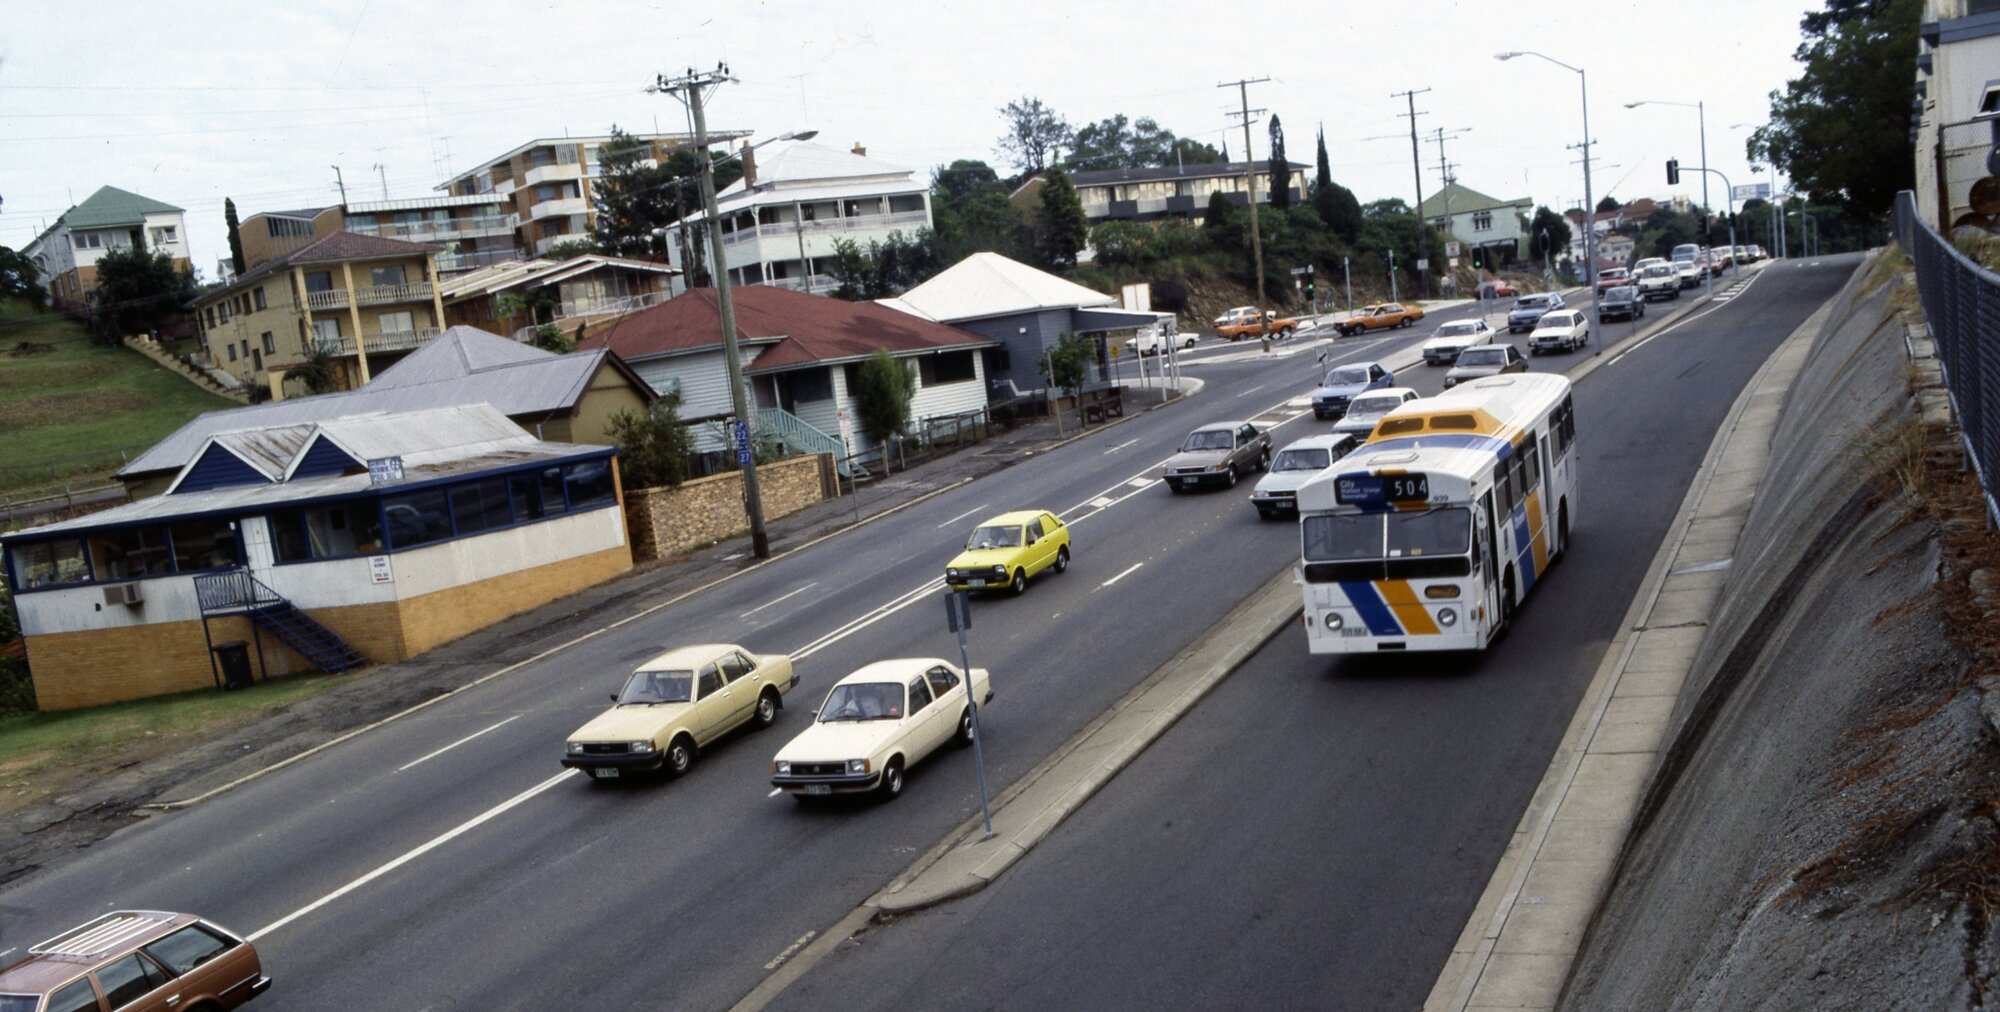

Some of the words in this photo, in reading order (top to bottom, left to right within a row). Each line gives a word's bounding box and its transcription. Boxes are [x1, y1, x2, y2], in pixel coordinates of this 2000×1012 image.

[736, 431, 747, 440] 22
[740, 453, 750, 462] 27
[1340, 480, 1355, 489] City
[1394, 480, 1427, 496] 504
